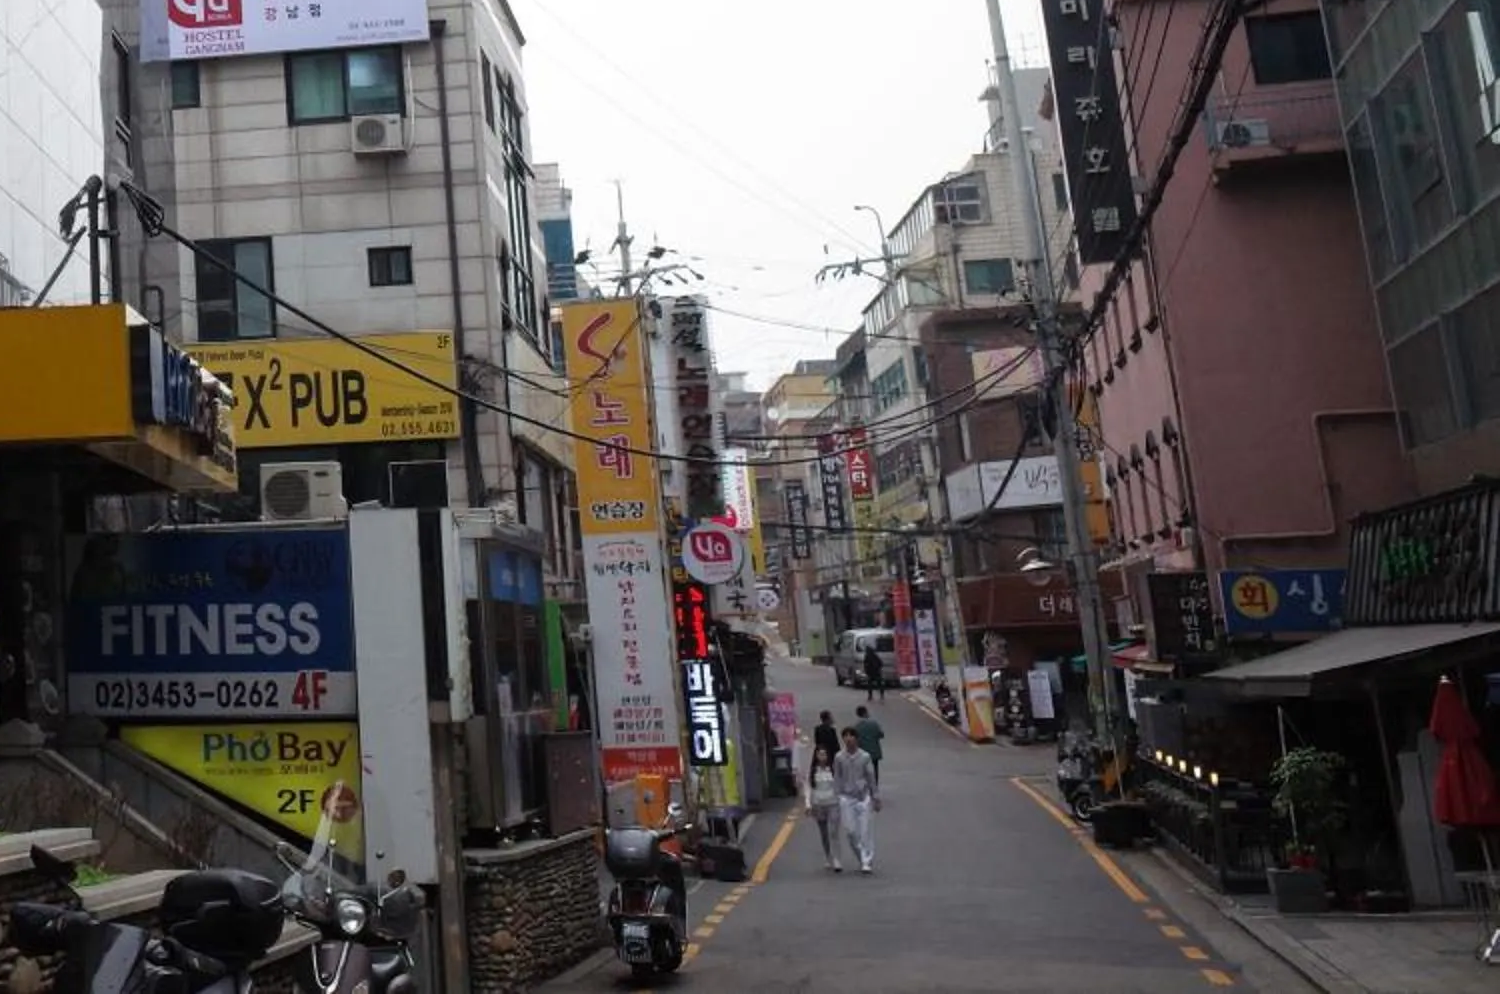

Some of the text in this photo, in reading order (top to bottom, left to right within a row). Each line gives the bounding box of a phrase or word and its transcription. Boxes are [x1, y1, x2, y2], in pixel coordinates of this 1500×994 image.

[184, 29, 245, 43] HOSTEL
[184, 42, 246, 56] GANGNAM
[289, 369, 369, 428] PUB
[591, 391, 633, 478] 노래
[591, 501, 645, 522] 연습장
[1238, 580, 1270, 613] 회
[100, 601, 322, 656] FITNESS
[95, 670, 329, 710] 02)3453-0262 4F
[276, 732, 347, 767] Bay
[277, 788, 316, 815] 2F
